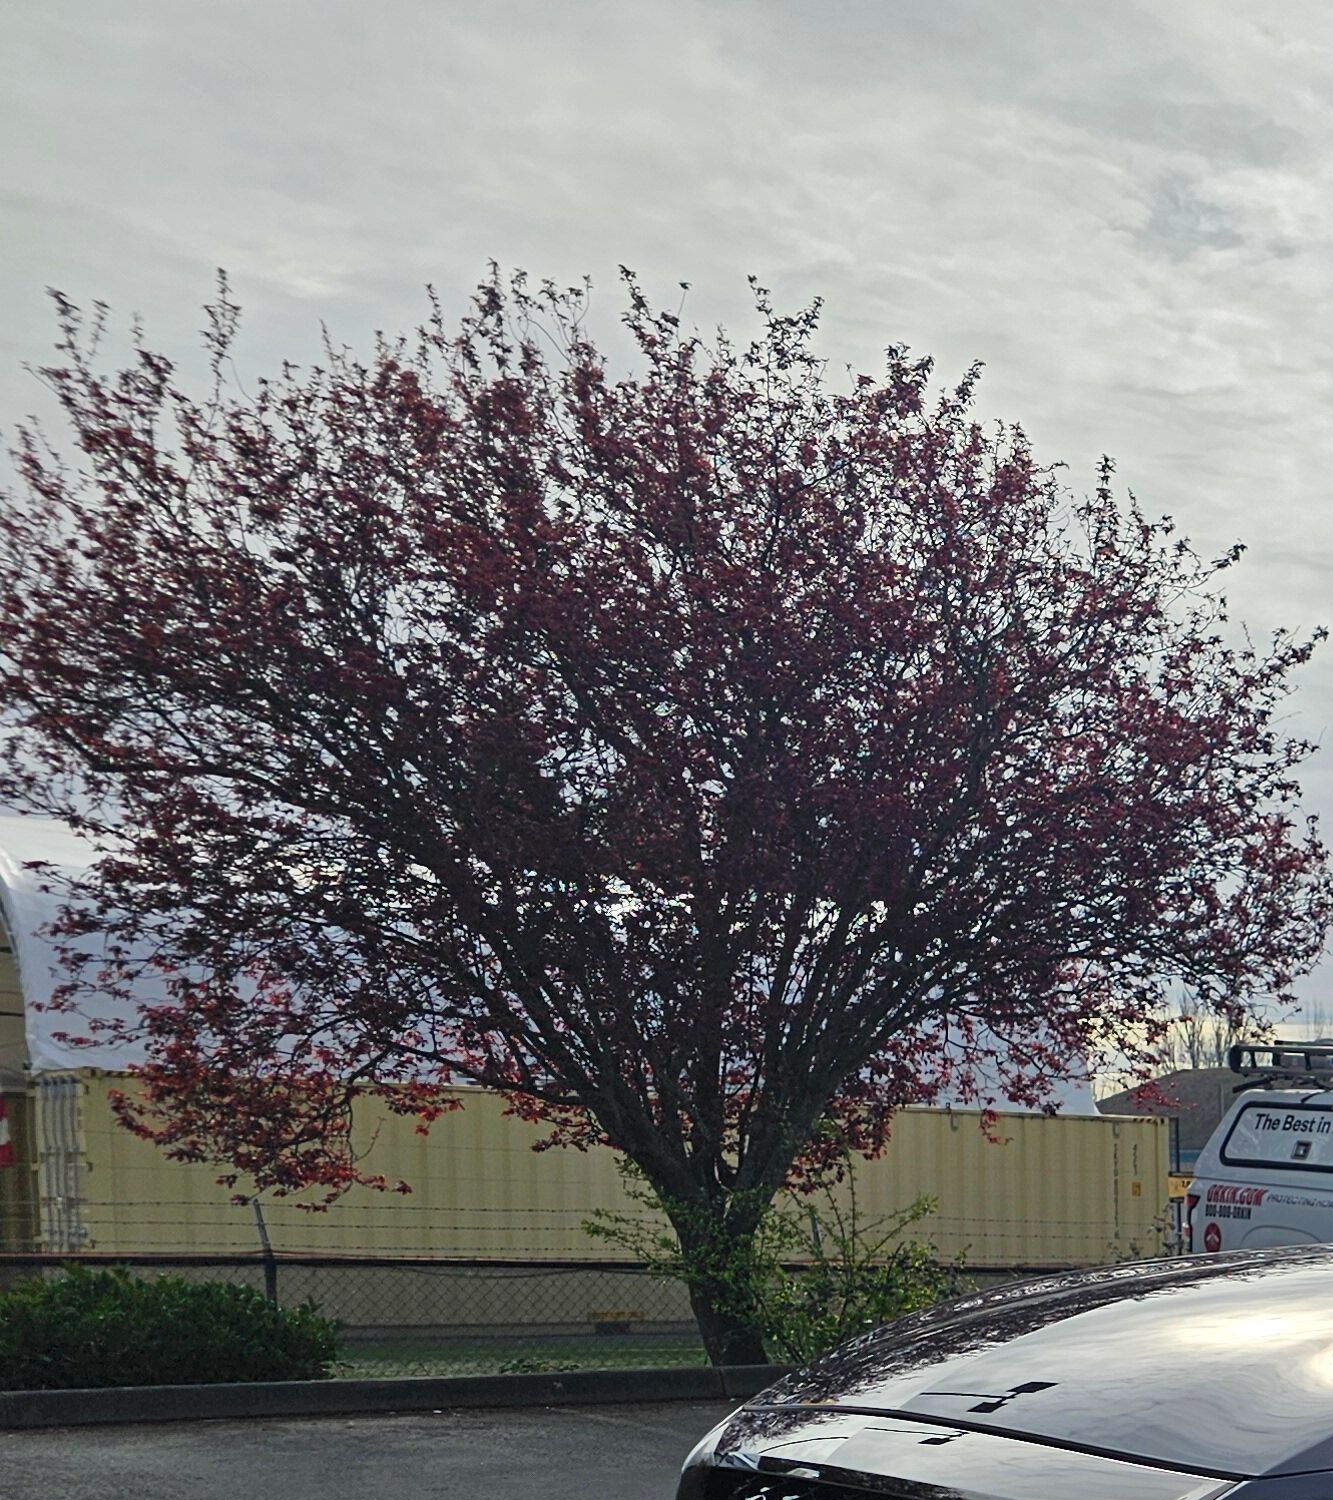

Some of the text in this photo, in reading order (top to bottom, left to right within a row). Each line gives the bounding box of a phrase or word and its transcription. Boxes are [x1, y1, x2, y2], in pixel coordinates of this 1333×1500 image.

[1254, 1113, 1281, 1131] The
[1282, 1114, 1315, 1133] Best
[1316, 1116, 1331, 1134] in
[1207, 1184, 1268, 1206] ORKIN.COM
[1267, 1193, 1316, 1207] PROTECTING
